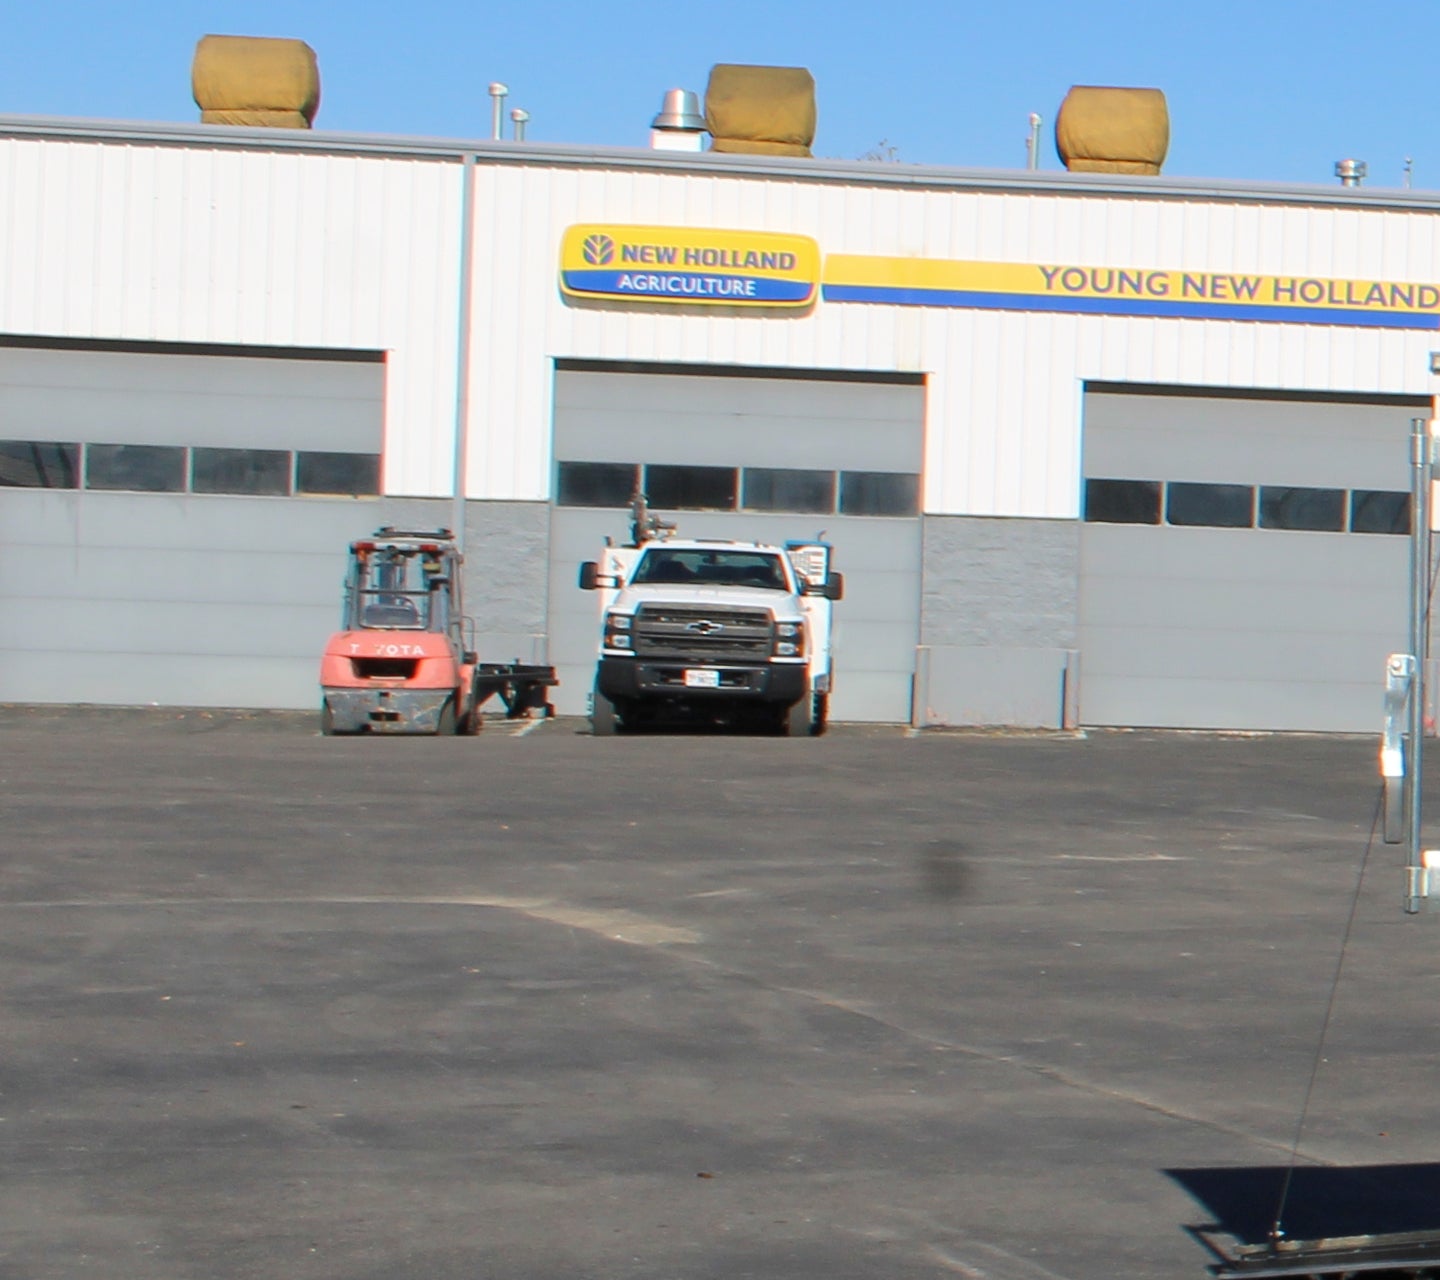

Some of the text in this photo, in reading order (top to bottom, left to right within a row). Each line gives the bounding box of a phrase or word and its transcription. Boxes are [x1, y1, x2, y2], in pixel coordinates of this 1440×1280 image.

[622, 243, 797, 270] NEW HOLLAND
[618, 274, 757, 297] AGRICULTURE
[1038, 265, 1170, 296] YOUNG
[1181, 272, 1262, 301] NEW
[350, 643, 425, 657] TYOTA
